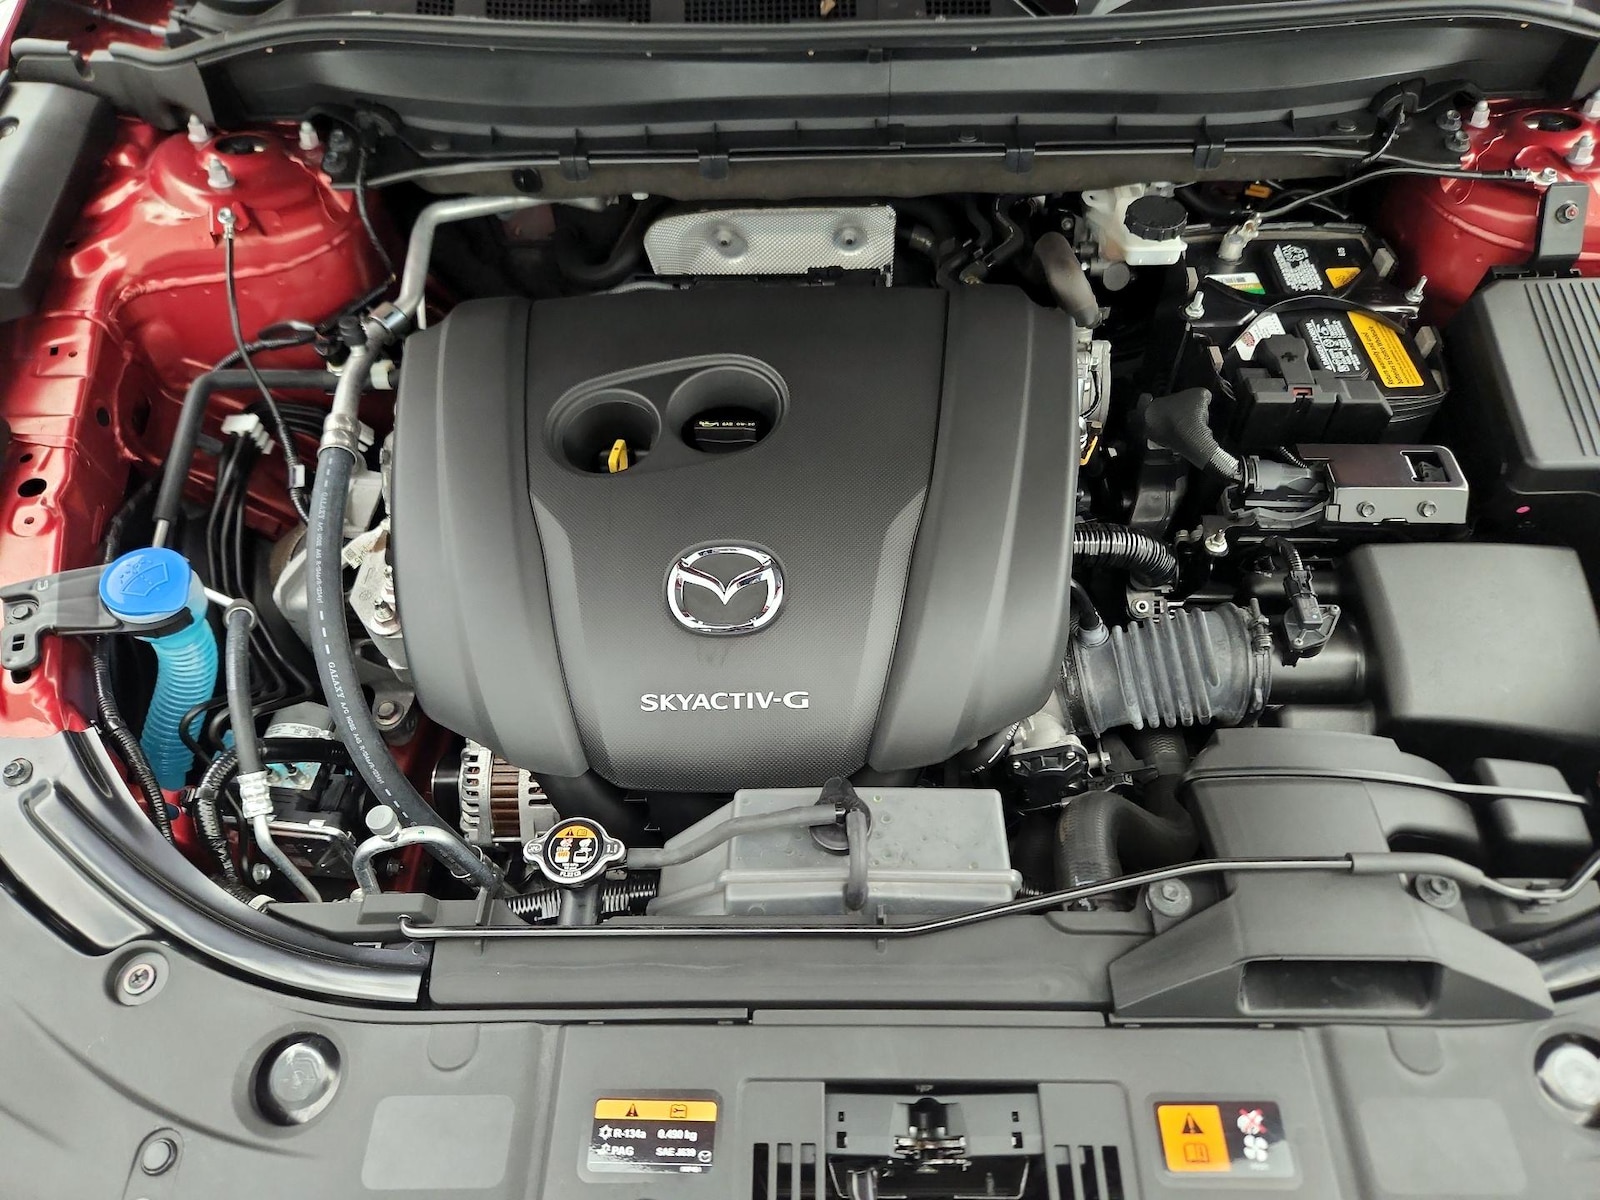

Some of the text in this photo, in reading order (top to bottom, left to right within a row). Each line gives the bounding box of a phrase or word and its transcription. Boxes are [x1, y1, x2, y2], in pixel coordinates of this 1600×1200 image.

[318, 492, 328, 520] GALAXY
[328, 662, 345, 698] GALAXY
[340, 702, 350, 715] A/C
[346, 716, 357, 731] HOSE
[640, 691, 810, 712] SKYACTIV-G
[613, 1128, 647, 1139] R-134a
[684, 1129, 698, 1142] kg
[611, 1145, 635, 1157] PAG
[655, 1147, 676, 1157] SAE
